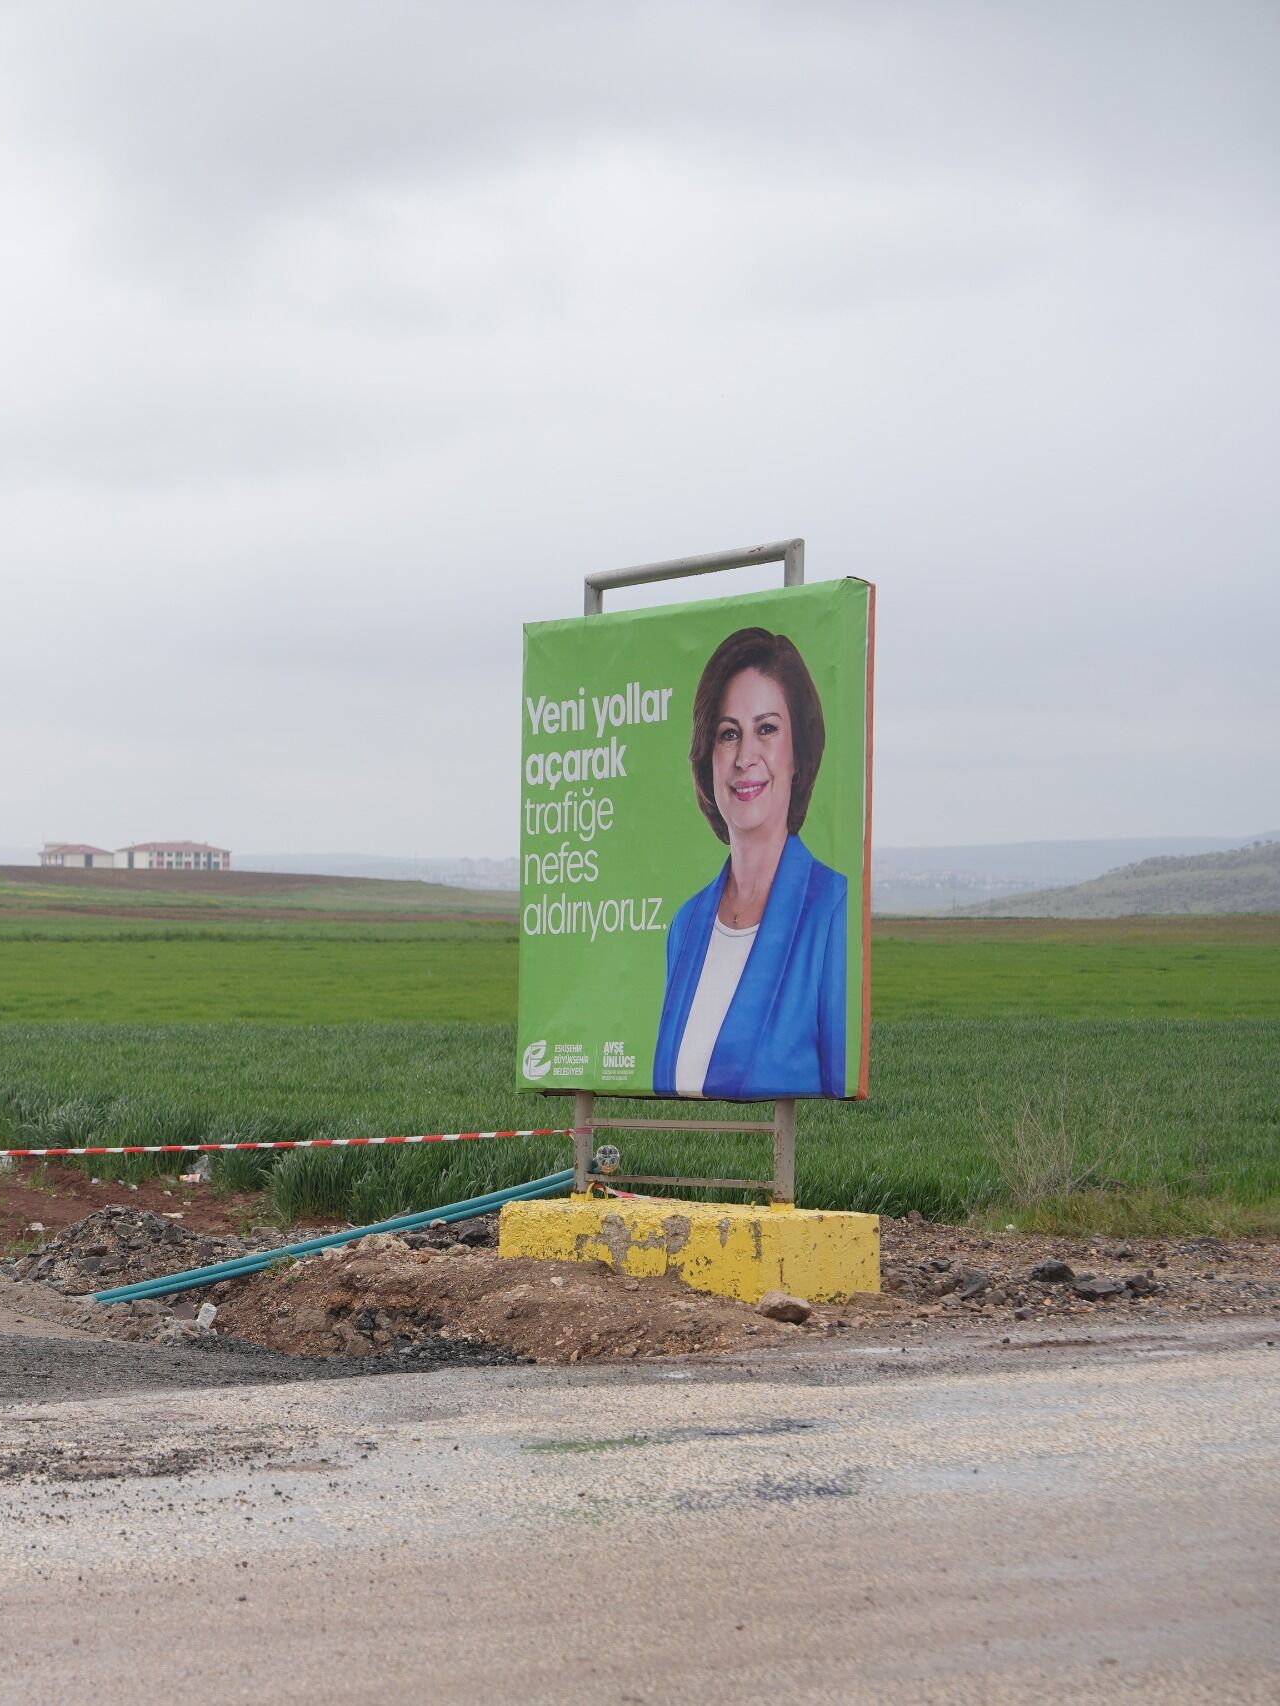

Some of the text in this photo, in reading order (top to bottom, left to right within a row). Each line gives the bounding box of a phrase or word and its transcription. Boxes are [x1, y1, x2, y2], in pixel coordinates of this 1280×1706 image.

[526, 682, 673, 738] Yeni yollar
[525, 736, 627, 790] açarak
[524, 786, 614, 842] trafiğe
[524, 841, 599, 886] nefes
[523, 893, 667, 942] aldırıyoruz.
